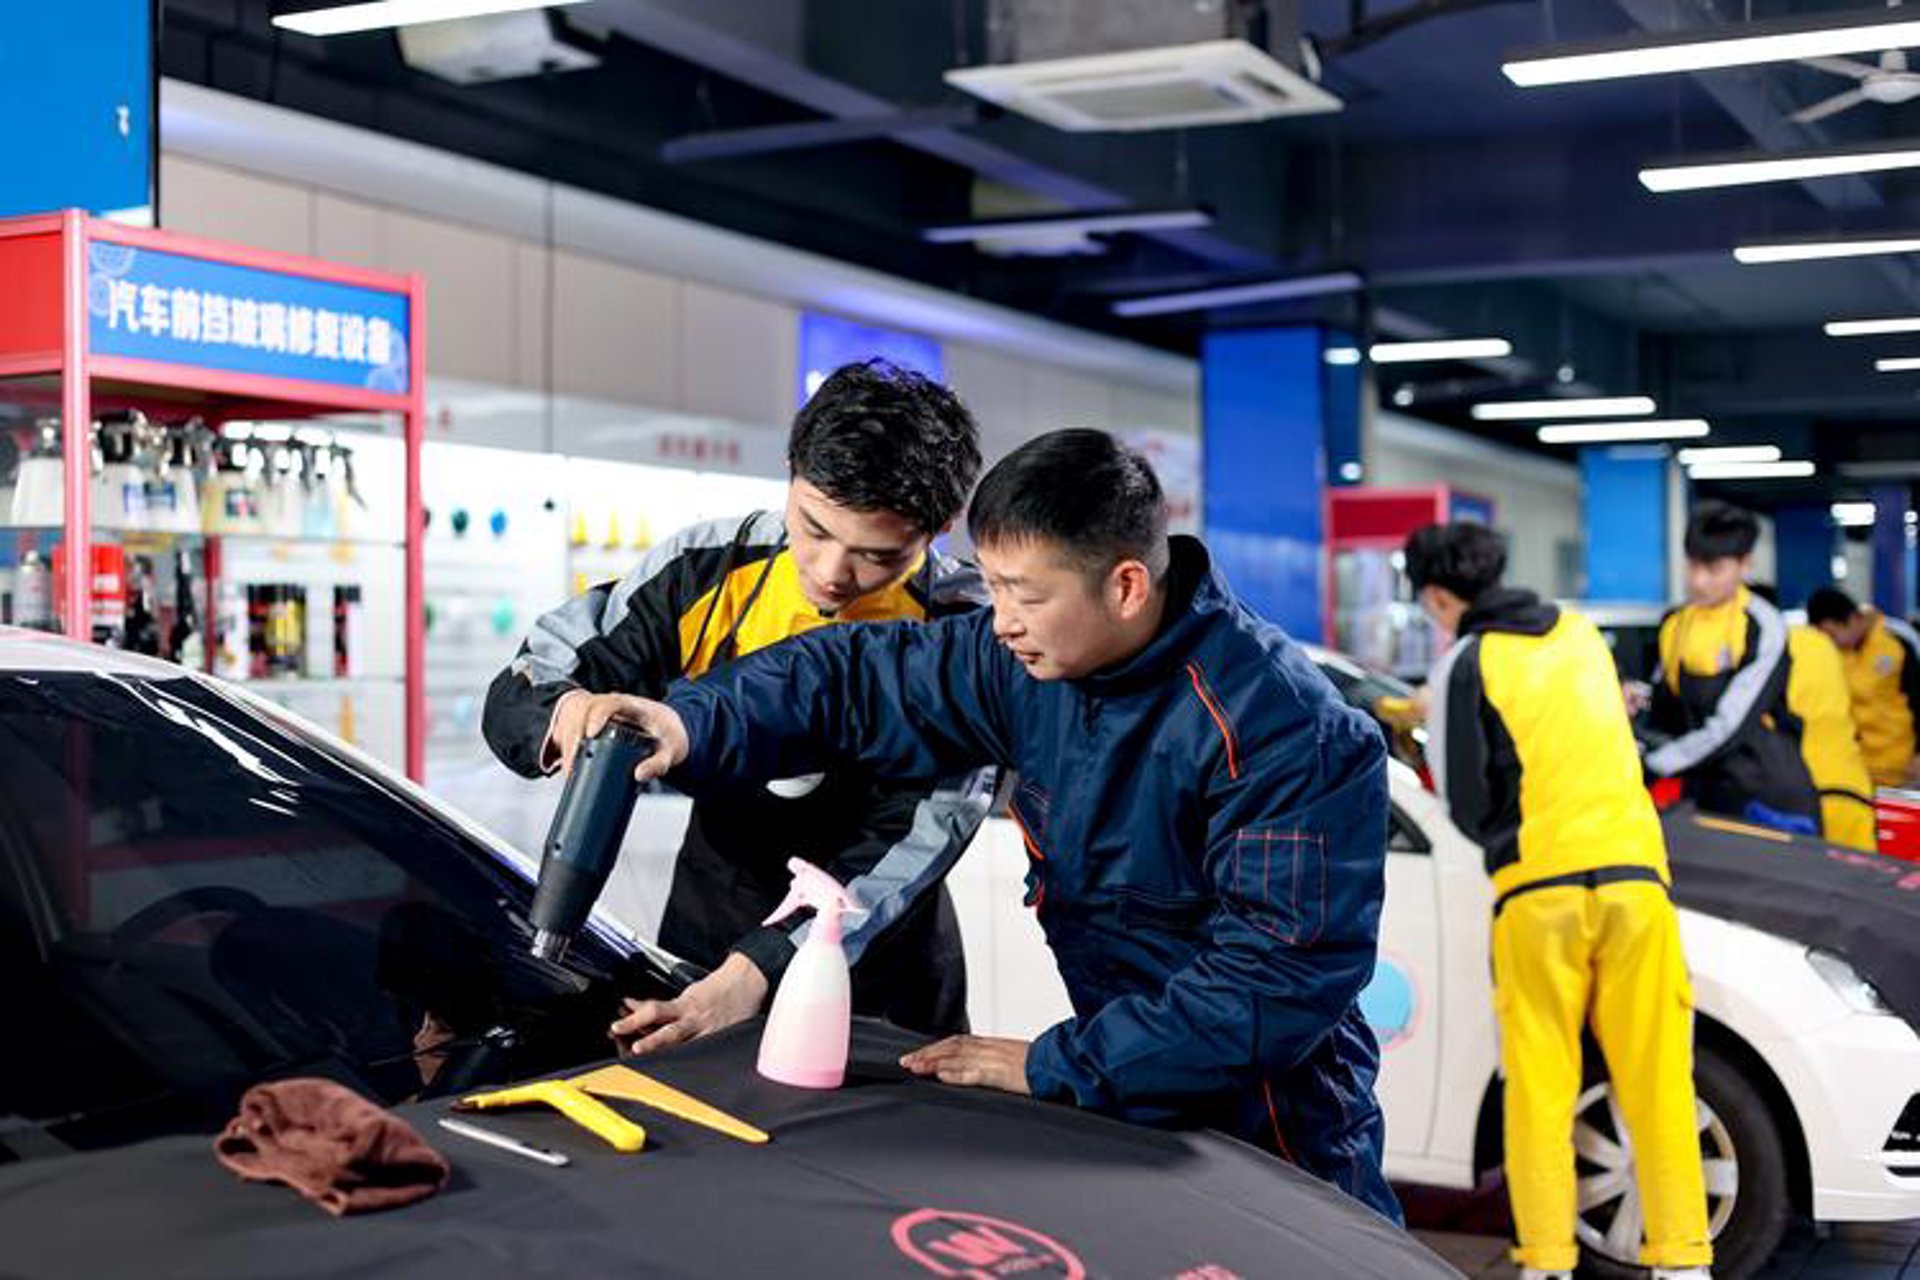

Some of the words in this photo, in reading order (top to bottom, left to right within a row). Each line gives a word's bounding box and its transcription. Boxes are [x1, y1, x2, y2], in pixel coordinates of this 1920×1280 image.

[108, 279, 391, 366] 汽车前挡玻璃修复设备
